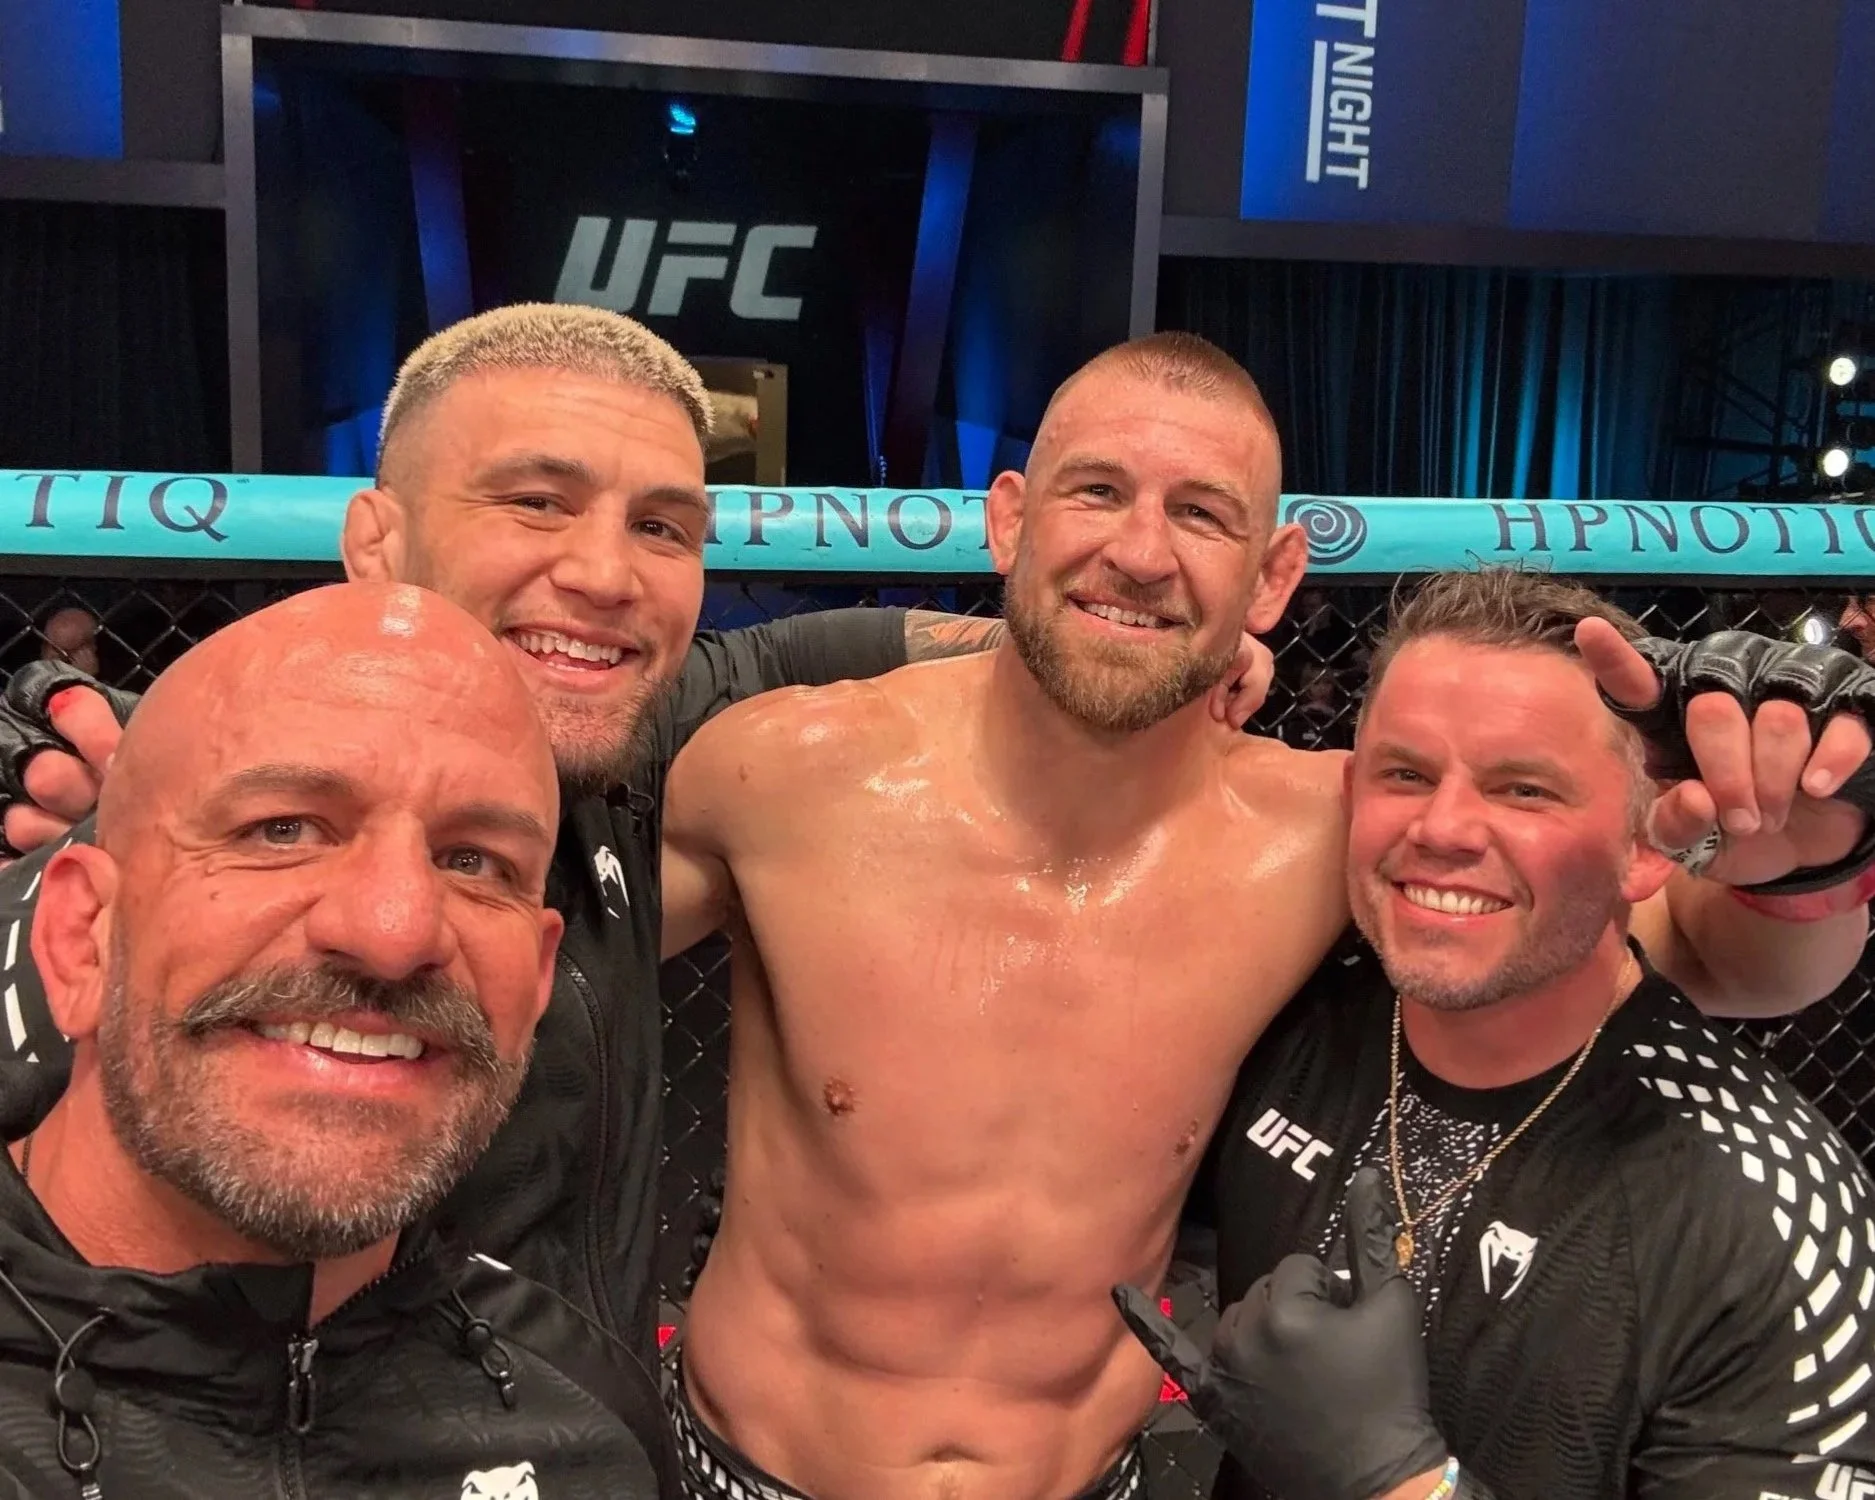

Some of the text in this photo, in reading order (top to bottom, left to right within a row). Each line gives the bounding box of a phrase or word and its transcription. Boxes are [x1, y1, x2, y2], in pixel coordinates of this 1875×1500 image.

[1326, 42, 1375, 189] NIGHT
[554, 216, 818, 320] UFC
[15, 473, 229, 542] TIQ
[1247, 1108, 1334, 1181] UFC
